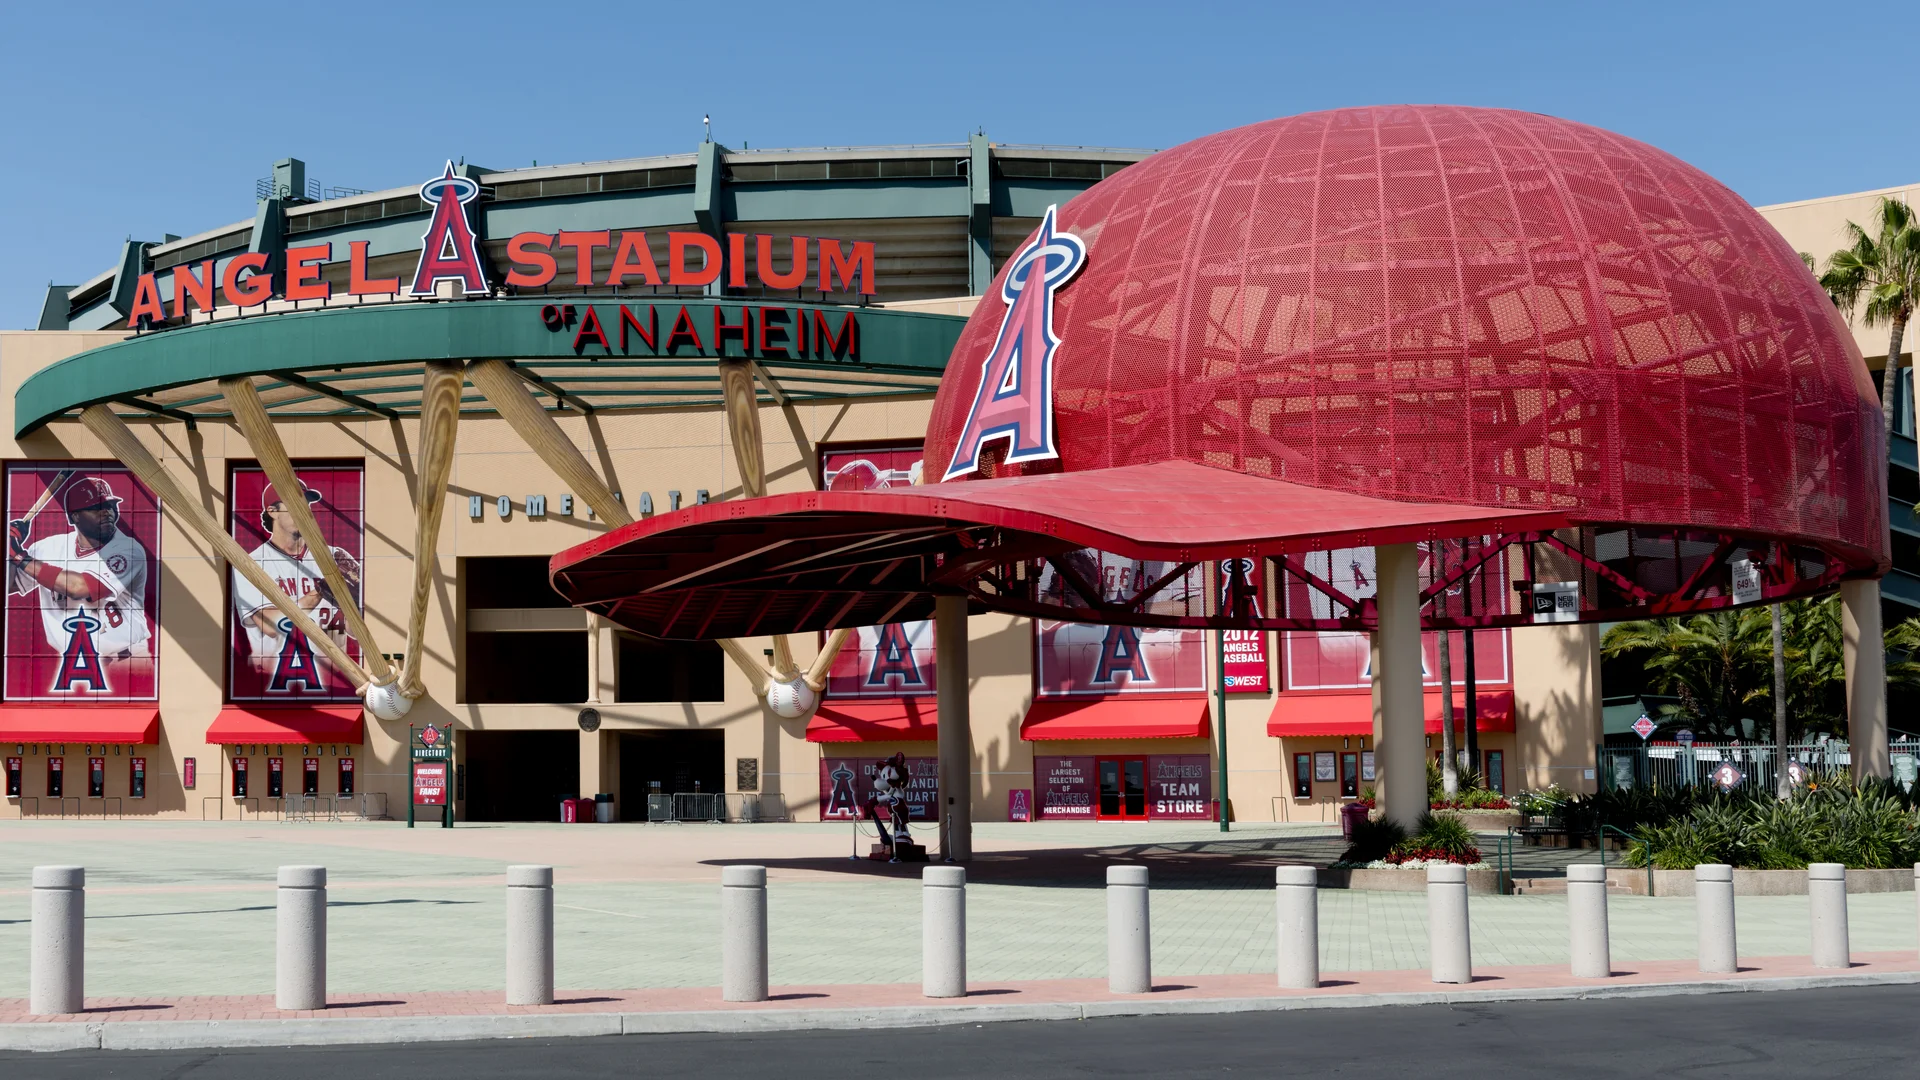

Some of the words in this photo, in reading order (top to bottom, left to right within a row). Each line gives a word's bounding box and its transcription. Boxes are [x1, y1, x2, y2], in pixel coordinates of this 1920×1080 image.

[127, 241, 400, 328] ANGEL
[504, 229, 877, 296] STADIUM
[540, 304, 574, 325] OF
[573, 304, 856, 356] ANAHEIM
[469, 494, 573, 518] HOME
[1223, 642, 1259, 652] ANGELS
[1223, 653, 1264, 663] ASEBALL
[415, 749, 446, 757] DIRECTORY
[1157, 760, 1202, 778] ANGELS
[1721, 767, 1733, 784] 3
[415, 775, 445, 786] ANGELS
[419, 787, 440, 796] FANS!
[1160, 783, 1200, 796] TEAM
[1046, 788, 1089, 806] ANGELS
[1043, 806, 1091, 814] MERCHANDISE
[1157, 800, 1204, 813] STORE
